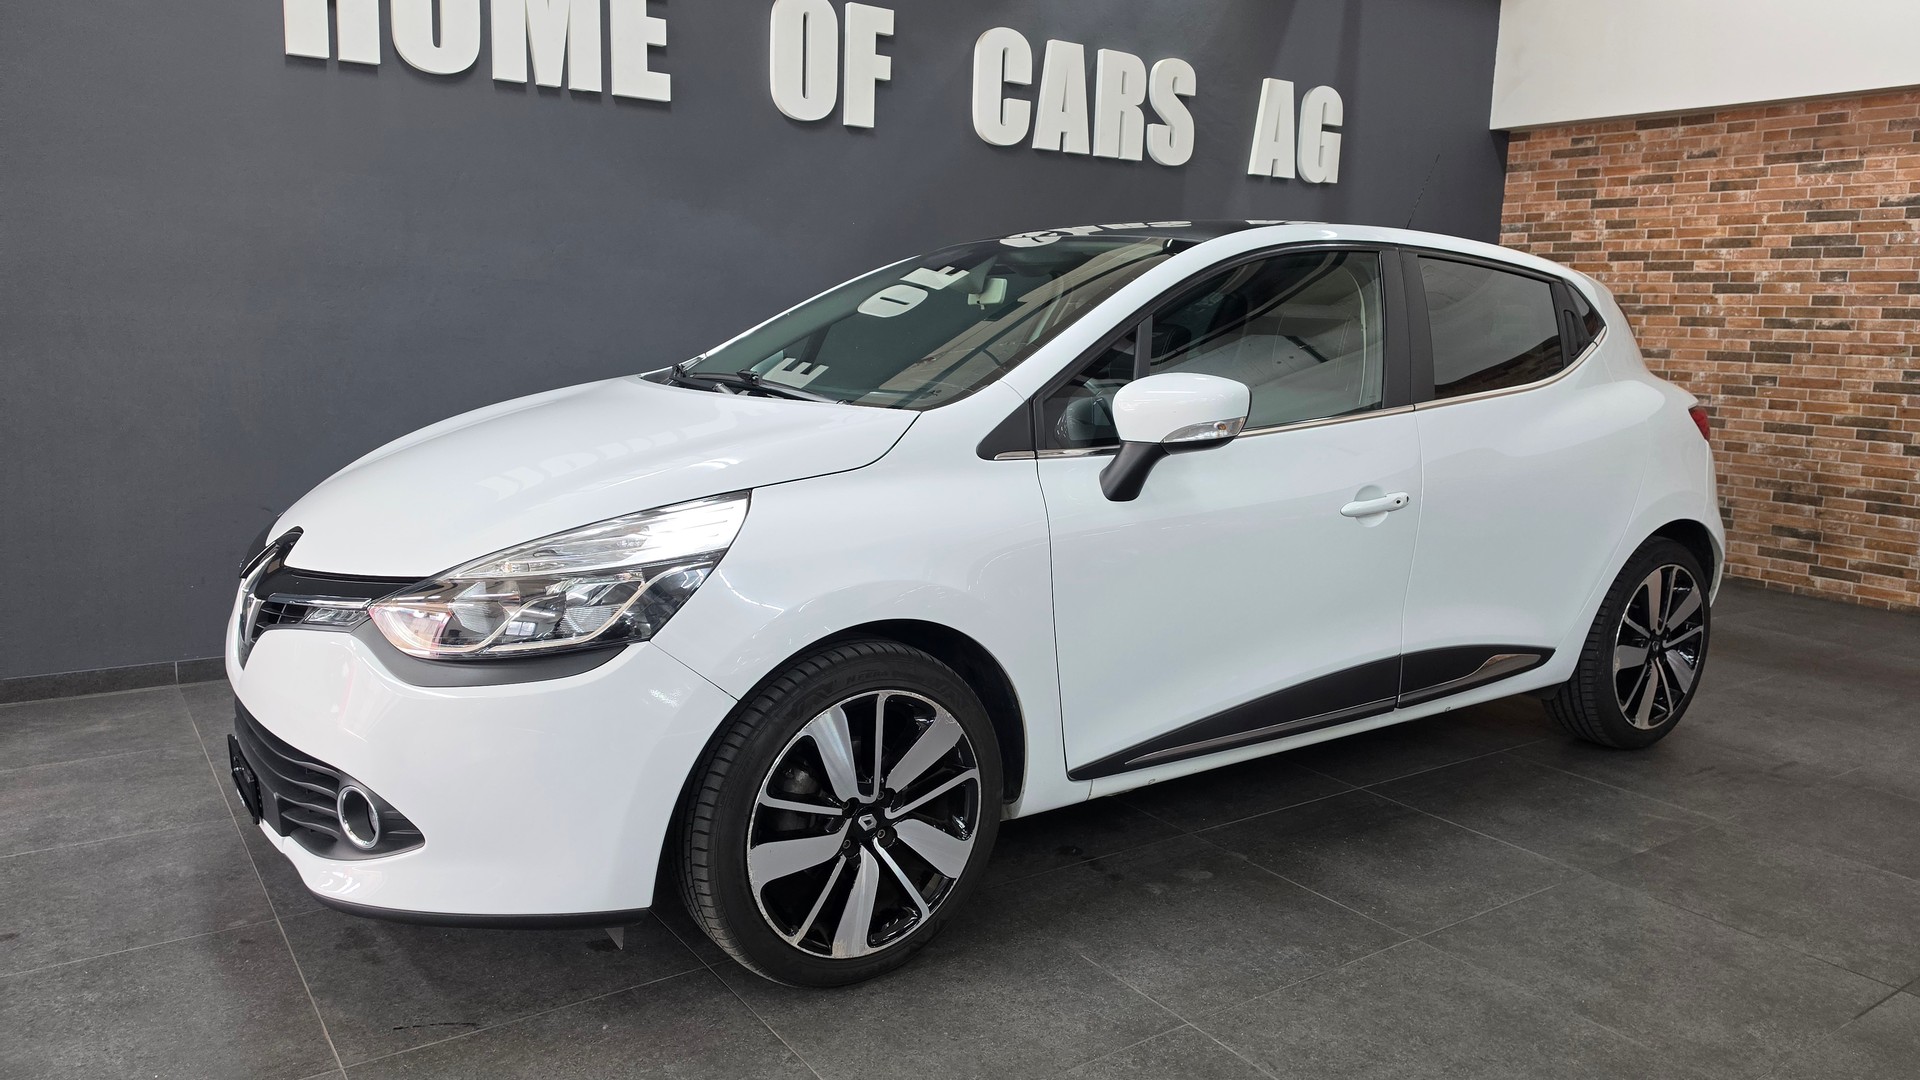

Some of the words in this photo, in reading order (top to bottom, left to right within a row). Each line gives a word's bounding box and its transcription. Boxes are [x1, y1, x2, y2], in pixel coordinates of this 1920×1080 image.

[769, 0, 895, 128] OF
[972, 26, 1196, 166] CARS
[1247, 77, 1344, 184] AG
